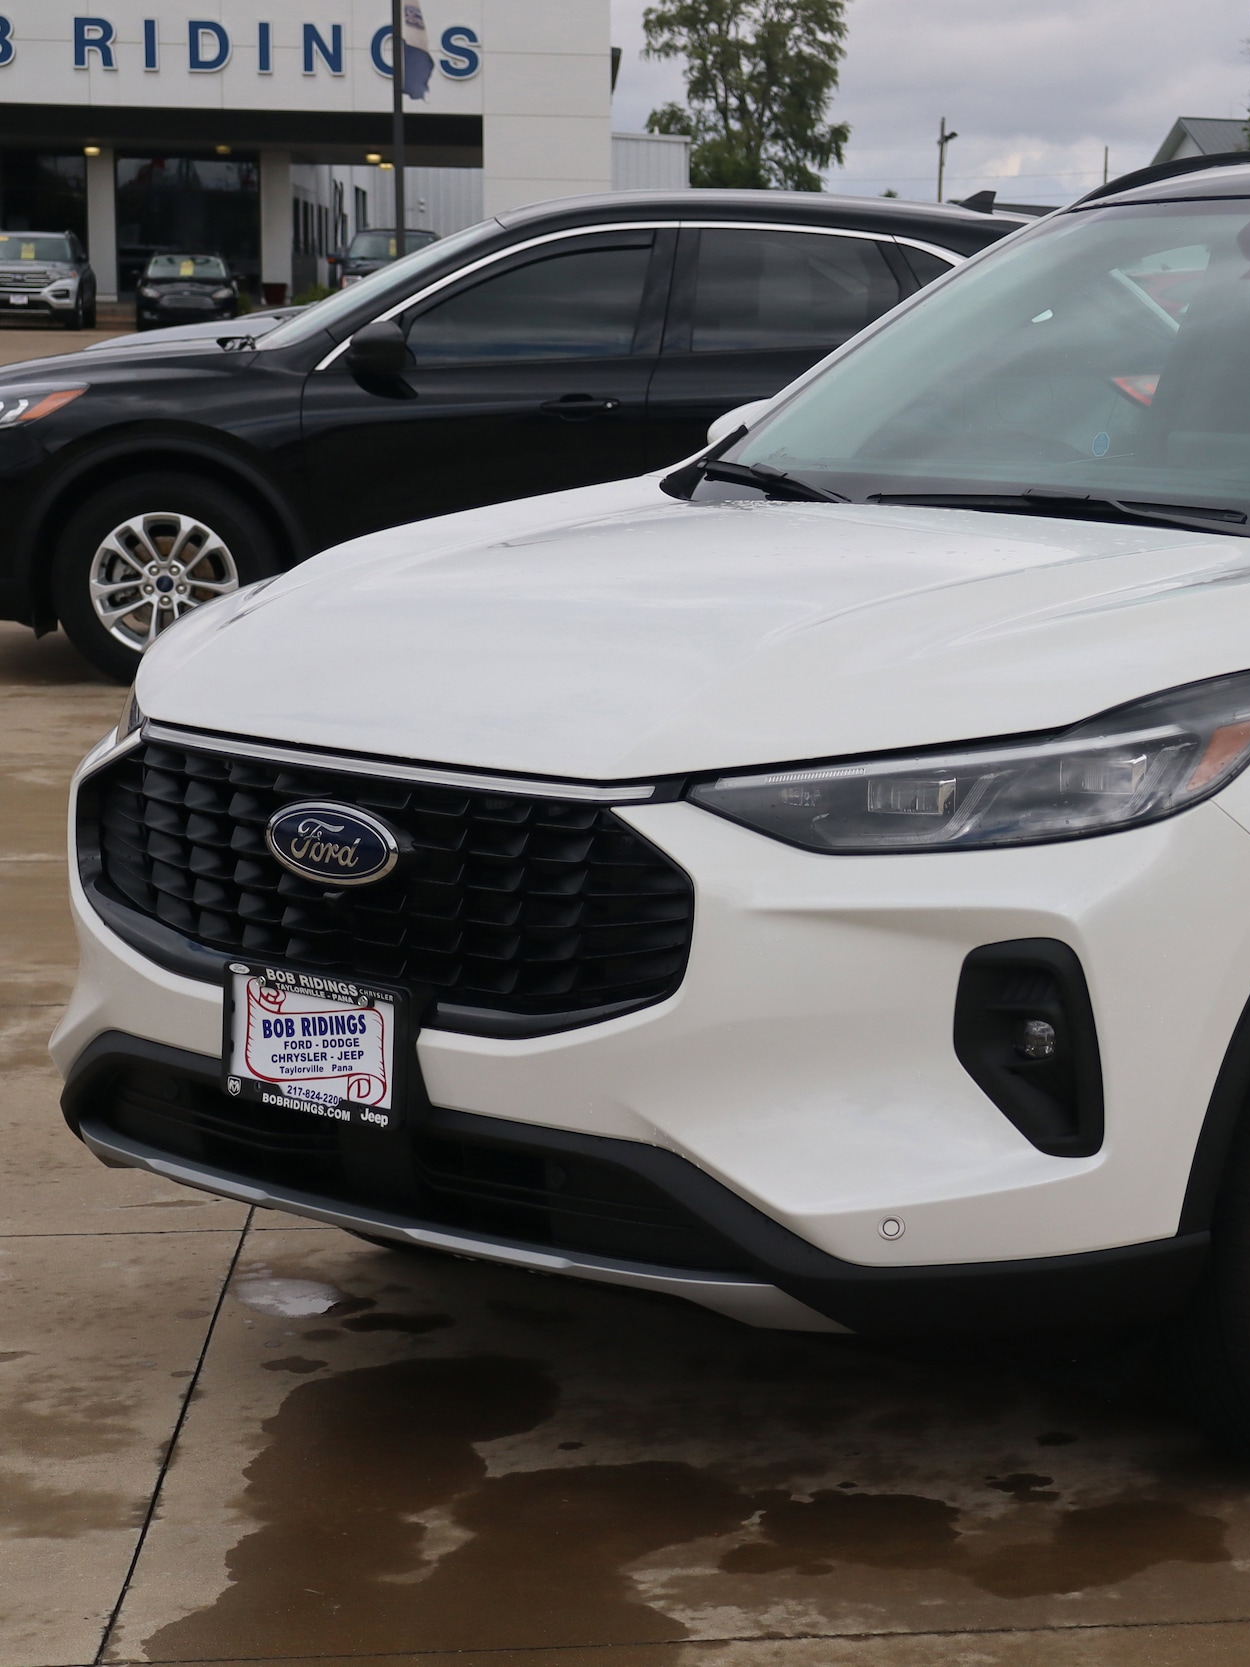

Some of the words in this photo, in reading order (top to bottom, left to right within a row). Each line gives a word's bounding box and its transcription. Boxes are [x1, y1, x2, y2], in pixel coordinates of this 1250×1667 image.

[290, 818, 361, 868] Ford
[266, 968, 296, 985] BOB
[299, 974, 359, 997] RIDINGS
[275, 982, 326, 999] TAYLORVILLE
[331, 993, 354, 1004] PANA
[359, 988, 394, 1002] CHRYSLER
[262, 1018, 295, 1039] BOB
[301, 1014, 367, 1037] RIDINGS
[283, 1040, 312, 1051] FORD
[322, 1037, 360, 1049] DODGE
[271, 1052, 328, 1063] CHRYSLER
[337, 1050, 365, 1061] JEEP
[279, 1065, 324, 1076] Taylorville
[331, 1064, 353, 1073] Pana
[262, 1092, 351, 1121] BOBRIDINGS.COM
[360, 1107, 389, 1128] Jeep
